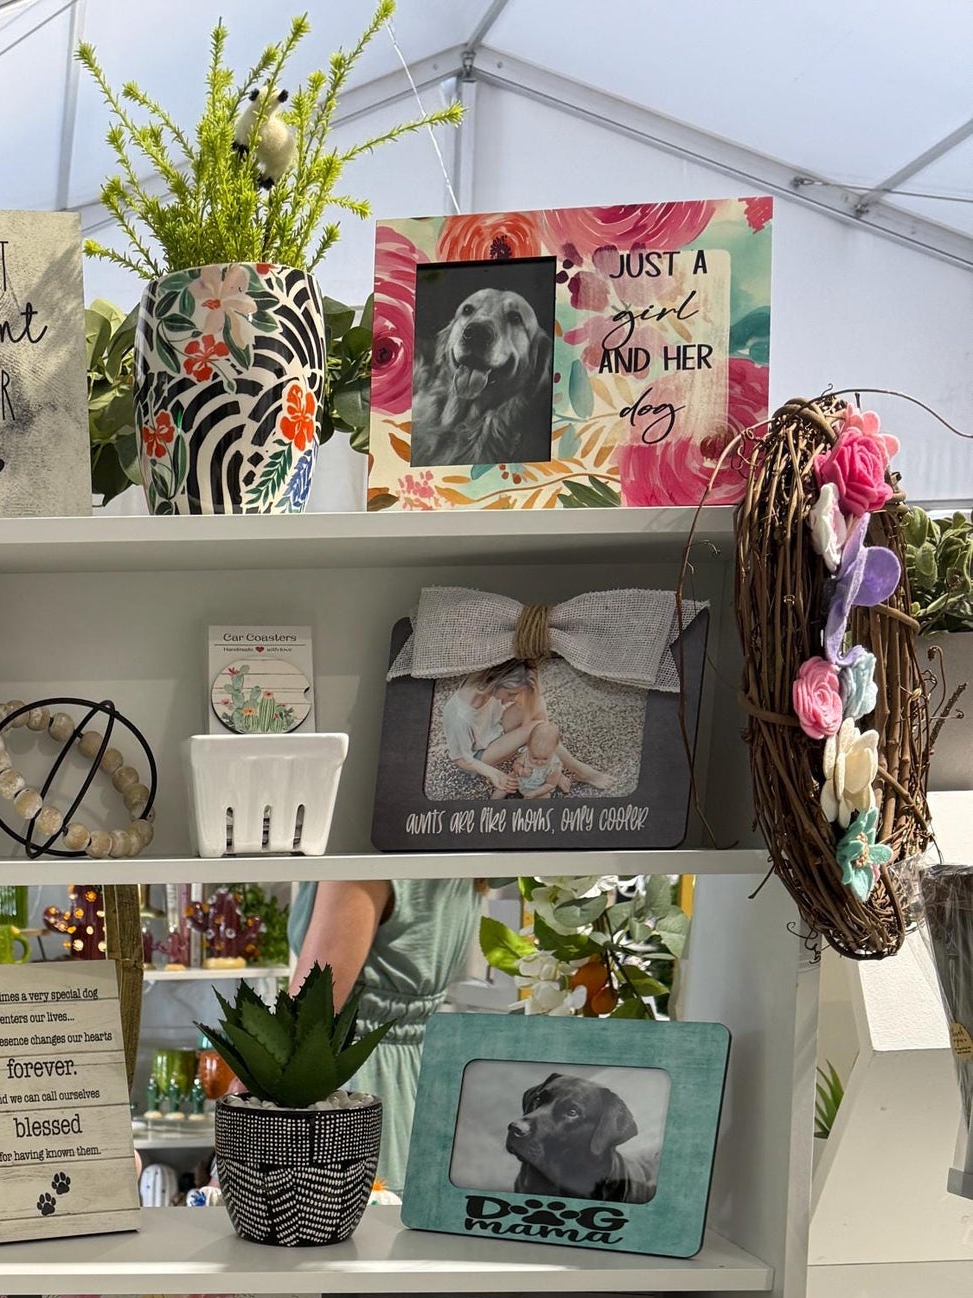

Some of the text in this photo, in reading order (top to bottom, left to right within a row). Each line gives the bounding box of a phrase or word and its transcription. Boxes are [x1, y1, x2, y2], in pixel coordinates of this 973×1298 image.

[609, 250, 707, 278] JUST A
[601, 290, 699, 351] girl
[599, 344, 713, 374] AND HER
[619, 387, 685, 444] dog
[223, 633, 297, 642] Car Coasters
[21, 993, 27, 1001] a
[29, 991, 49, 1002] very
[51, 989, 81, 1001] special
[83, 988, 98, 999] dog
[0, 1014, 28, 1025] enters
[30, 1013, 45, 1022] our
[30, 1034, 66, 1046] changes
[68, 1033, 83, 1043] our
[84, 1031, 113, 1042] hearts
[7, 1058, 77, 1079] forever.
[10, 1095, 22, 1103] we
[24, 1094, 40, 1103] can
[42, 1091, 58, 1102] call
[59, 1089, 100, 1101] ourselves
[13, 1114, 83, 1138] blessed
[0, 1146, 101, 1162] for having known them.
[464, 1217, 623, 1244] mama
